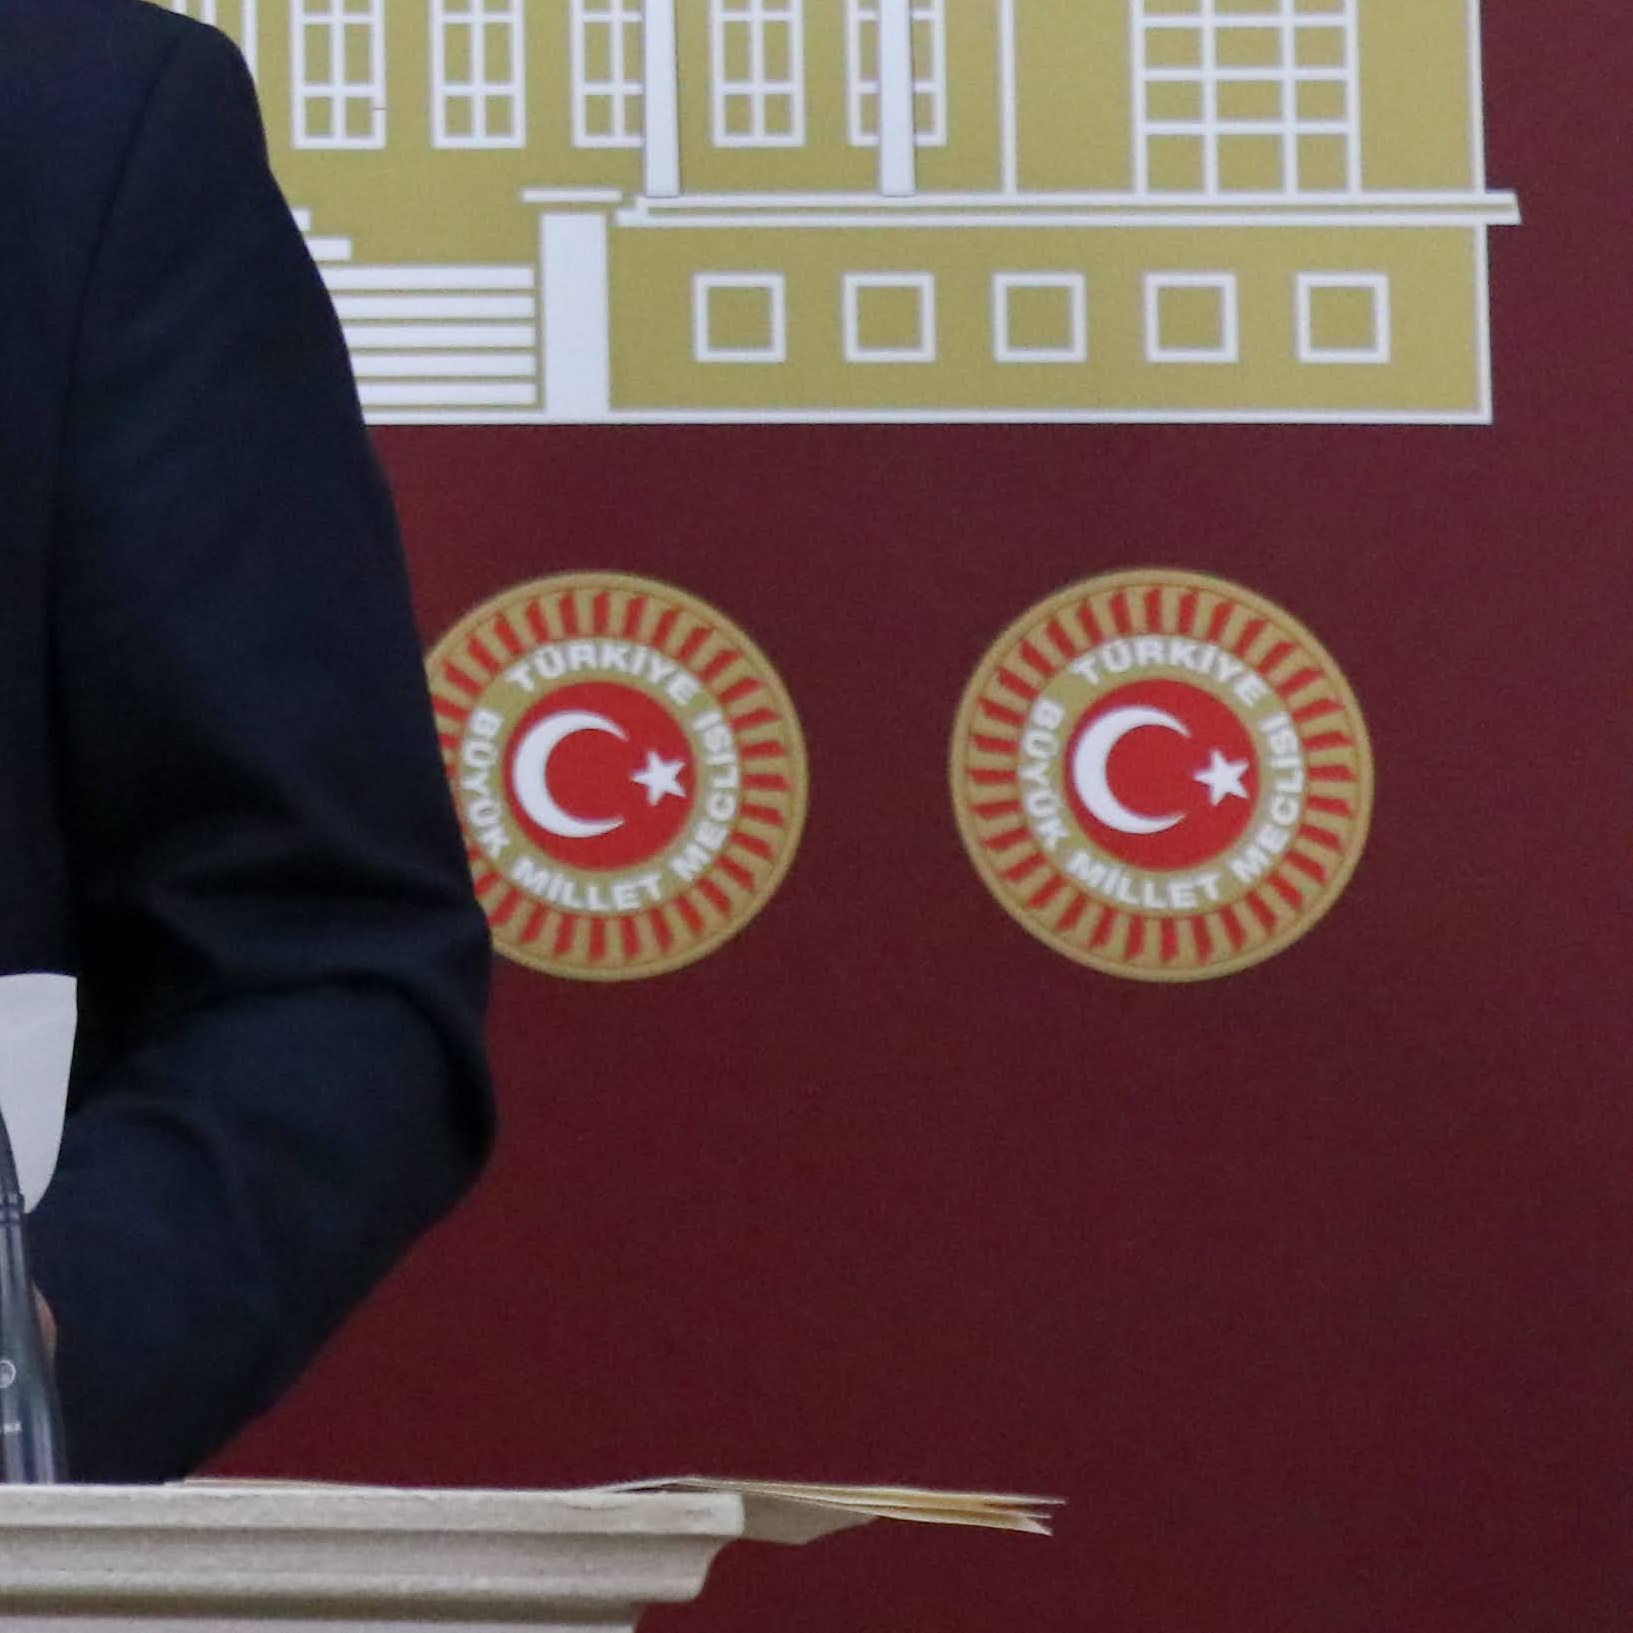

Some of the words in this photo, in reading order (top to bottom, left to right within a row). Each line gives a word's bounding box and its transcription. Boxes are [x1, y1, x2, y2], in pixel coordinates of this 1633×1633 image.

[505, 638, 701, 706] TÜRKİYE
[1069, 634, 1271, 709] TÜRKİYE
[460, 708, 511, 861] BÜYÜK
[1019, 697, 1069, 851] BÜYÜK
[509, 855, 664, 913] MİLLET
[1062, 849, 1225, 910] MİLLET
